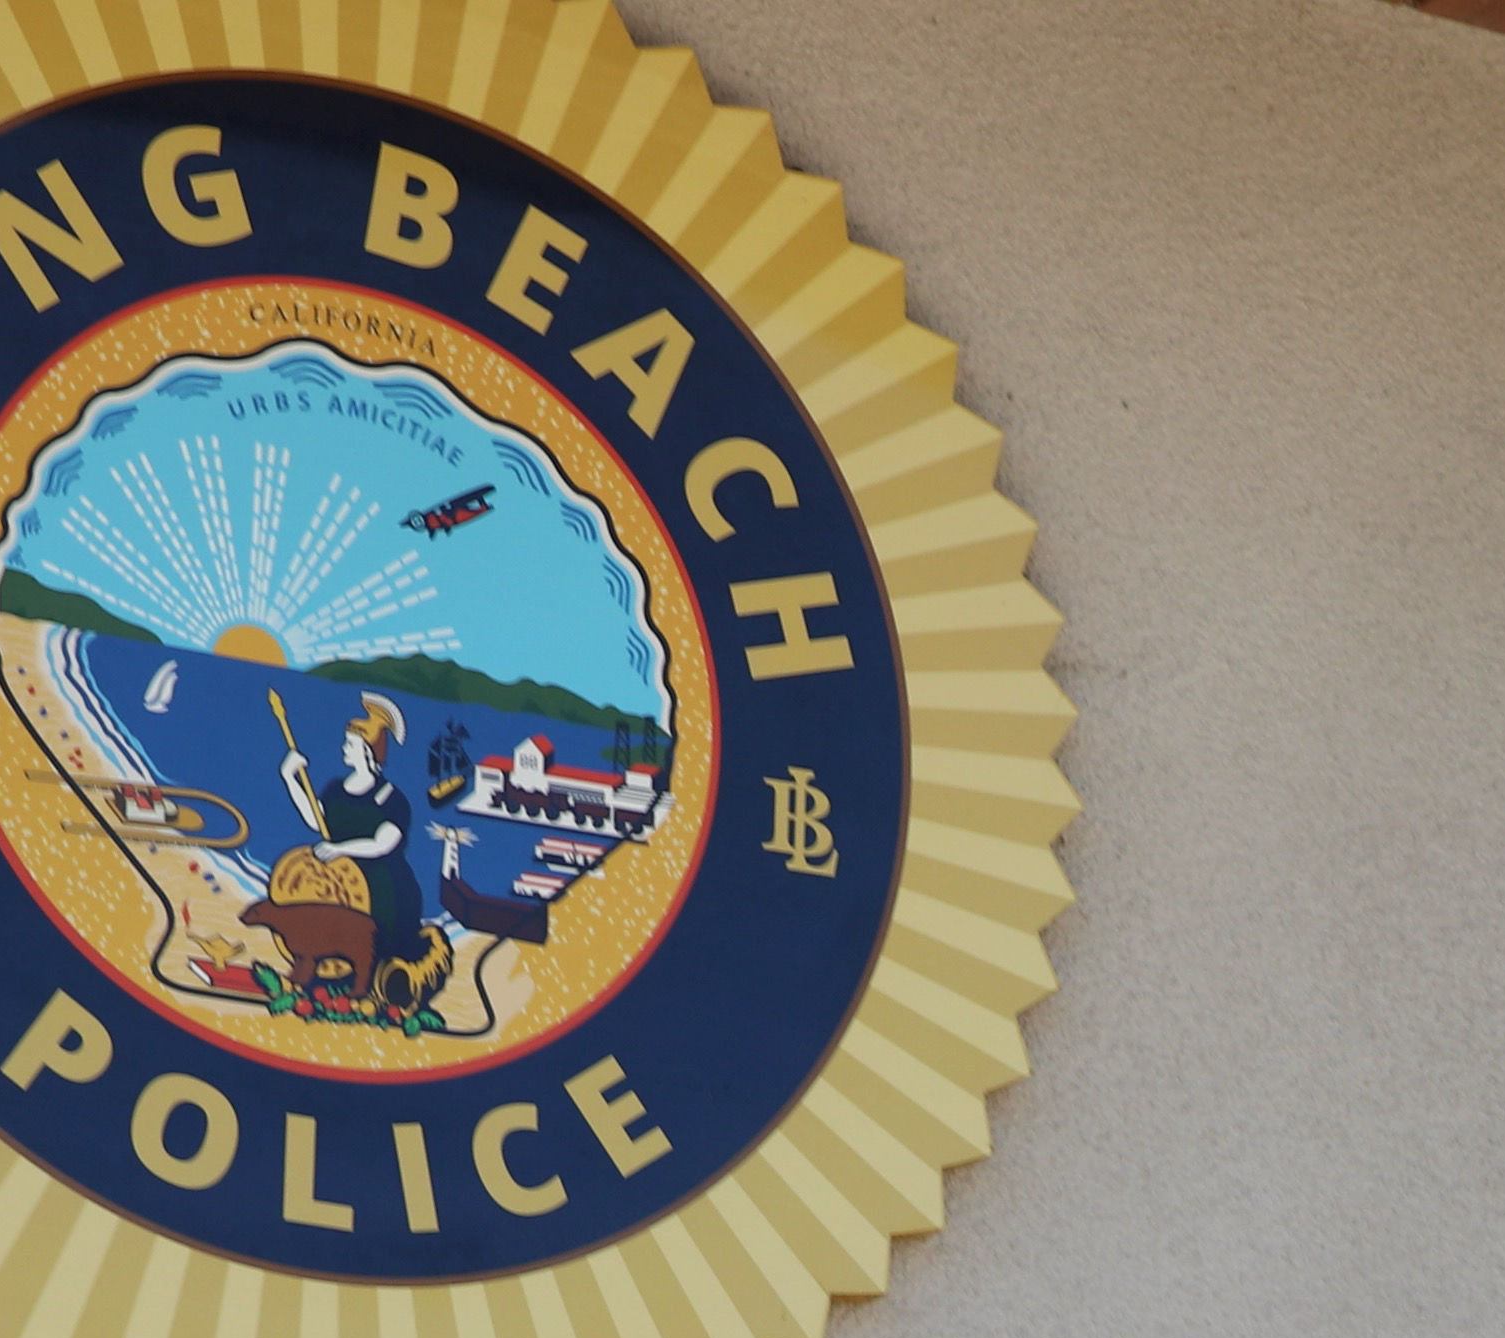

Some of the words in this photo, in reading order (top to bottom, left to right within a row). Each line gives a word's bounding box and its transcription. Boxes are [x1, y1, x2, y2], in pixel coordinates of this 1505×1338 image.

[249, 302, 437, 358] CALIFORNIA
[227, 390, 313, 420] URBS
[327, 394, 465, 468] AMICITIAE
[362, 141, 856, 682] BEACH
[0, 989, 674, 1234] POLICE
